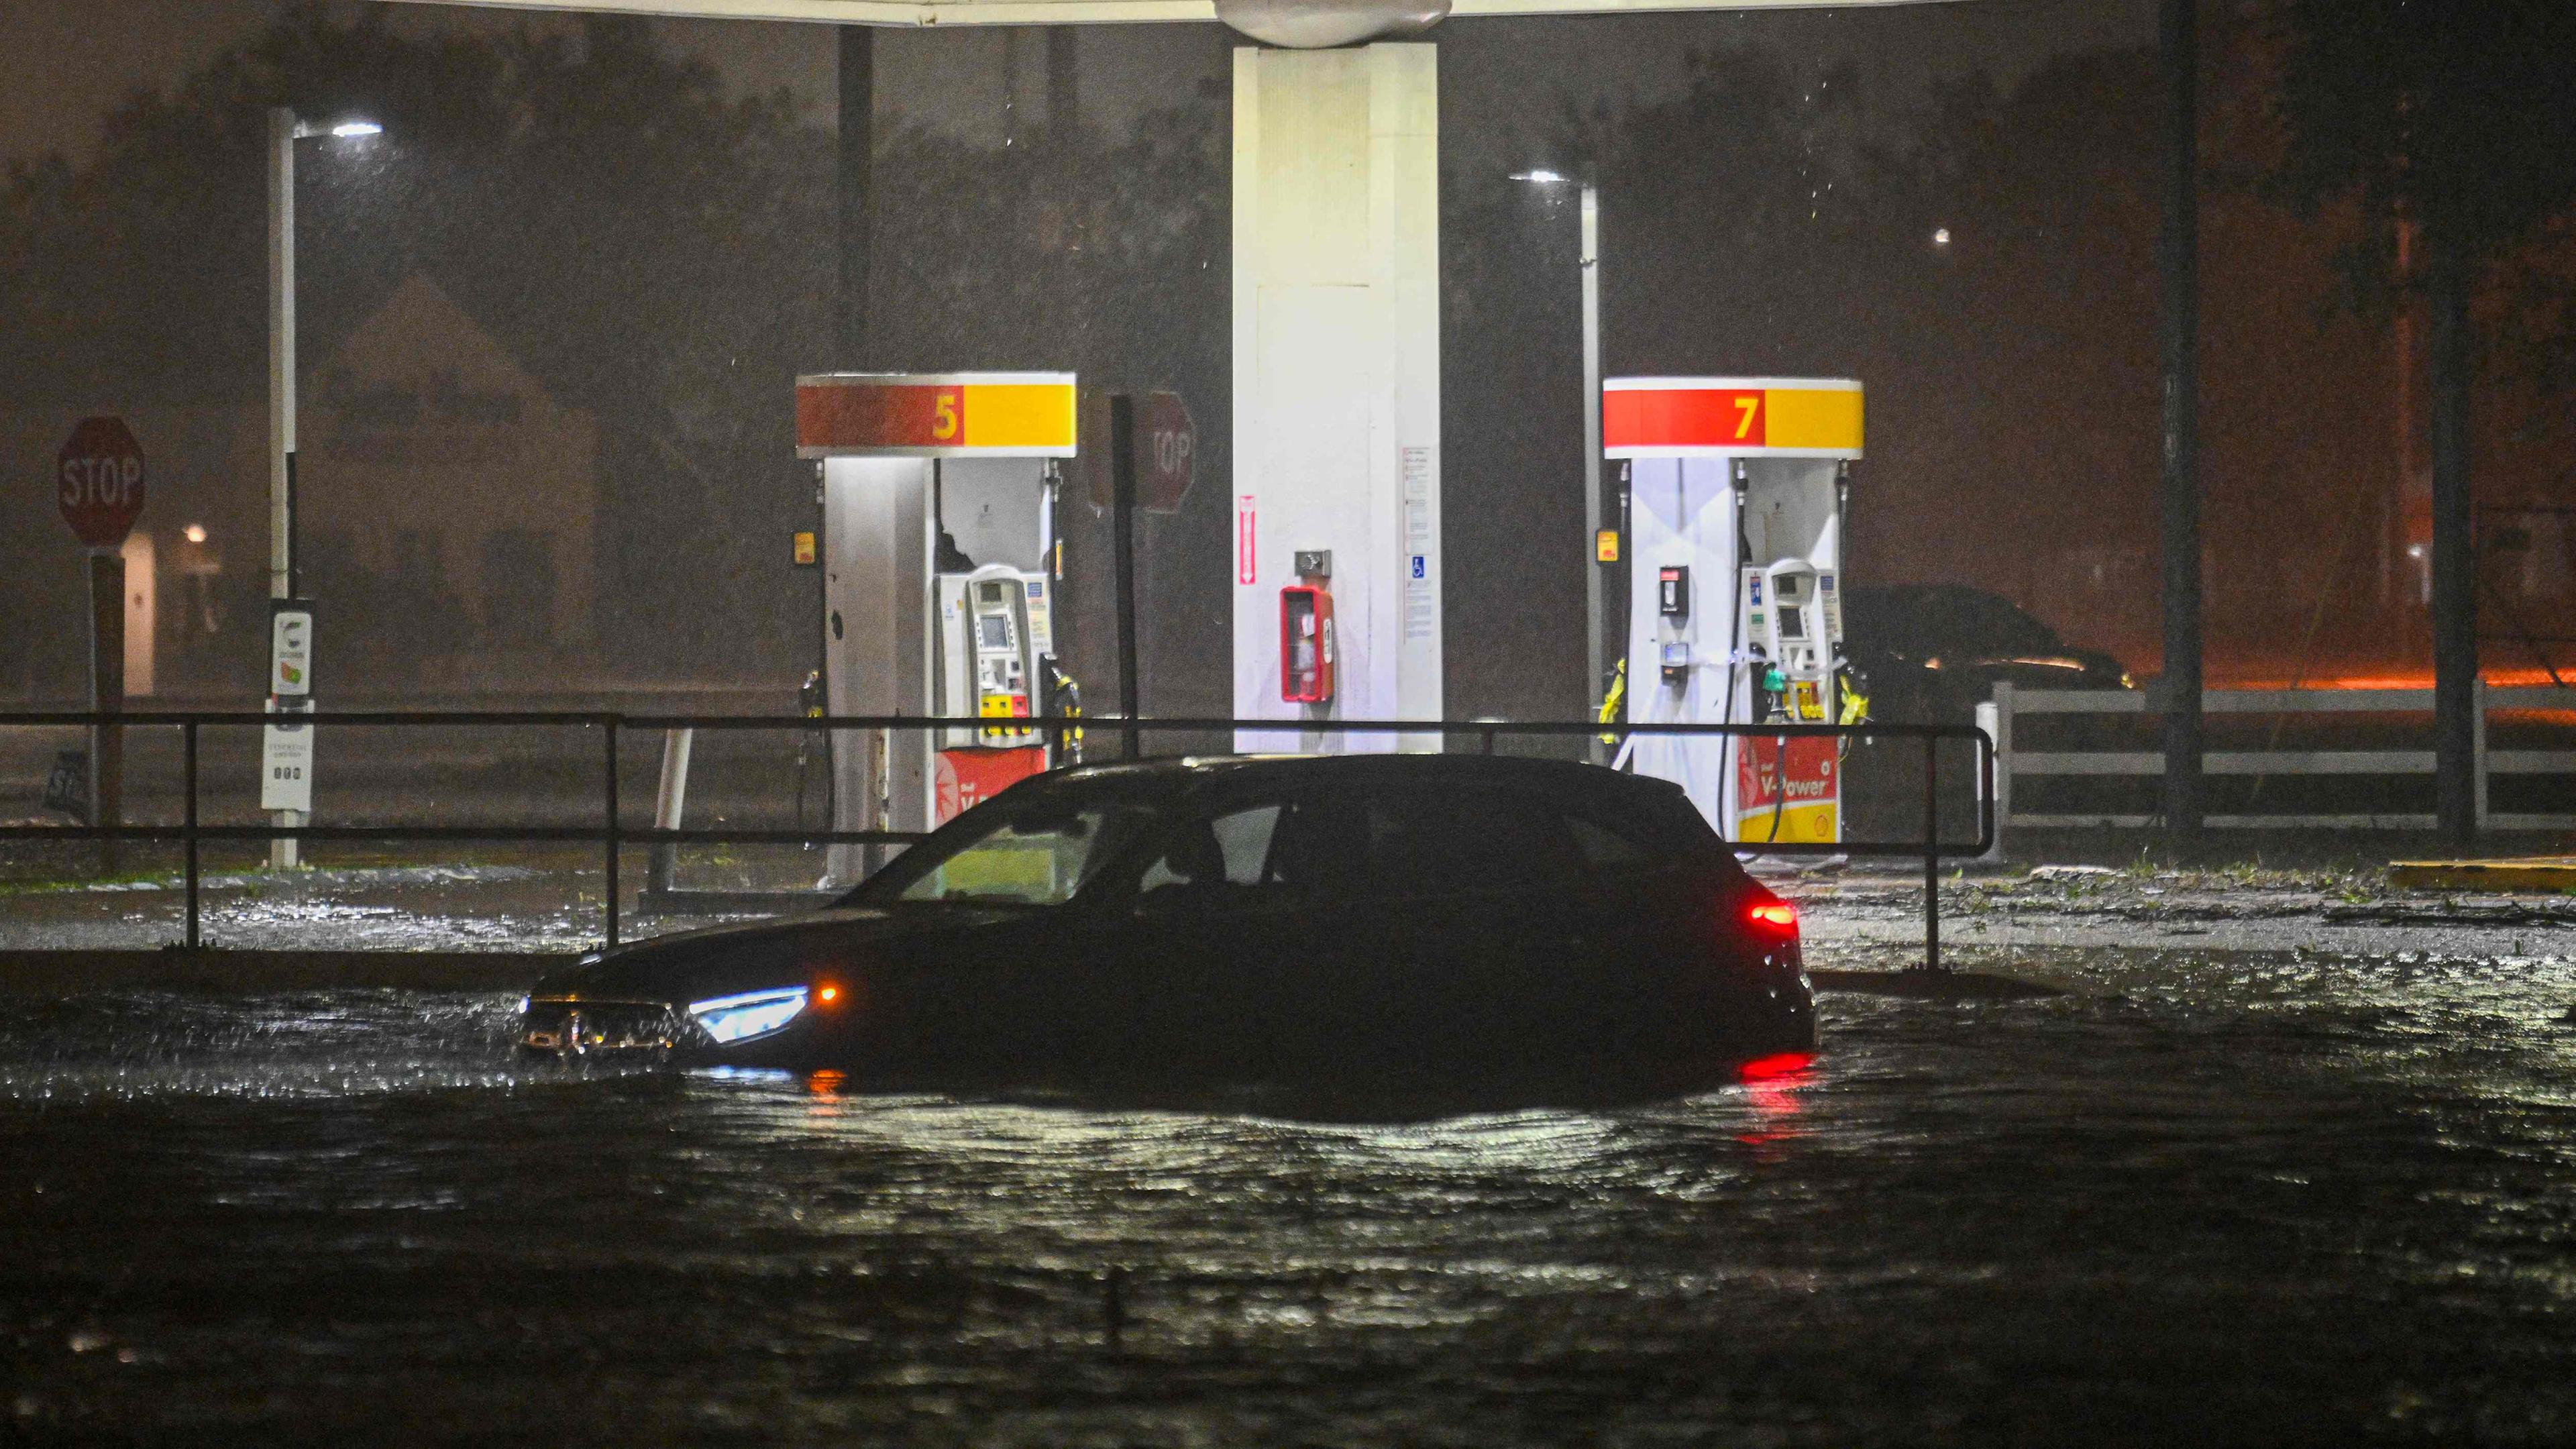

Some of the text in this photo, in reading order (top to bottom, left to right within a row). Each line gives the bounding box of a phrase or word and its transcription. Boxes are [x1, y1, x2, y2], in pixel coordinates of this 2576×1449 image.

[933, 395, 957, 438] 5
[1734, 398, 1758, 439] 7
[1152, 431, 1190, 472] TOP
[64, 458, 140, 504] STOP
